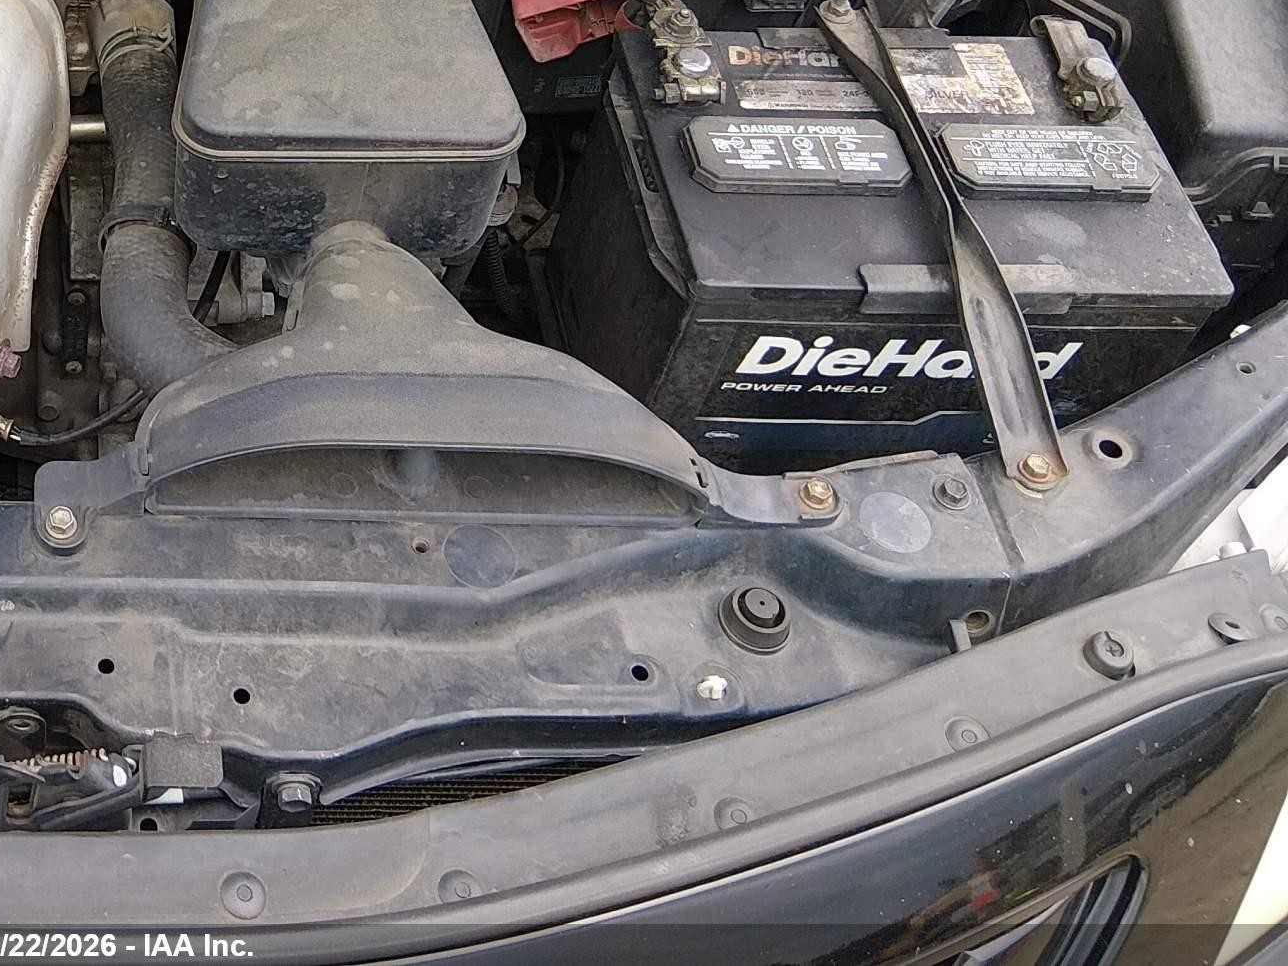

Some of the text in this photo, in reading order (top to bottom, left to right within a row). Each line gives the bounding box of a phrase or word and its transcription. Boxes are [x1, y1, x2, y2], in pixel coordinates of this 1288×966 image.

[740, 124, 795, 134] DANGER
[806, 125, 857, 135] POISON
[735, 336, 1084, 381] DieHad
[721, 381, 889, 395] POWER AHEAD
